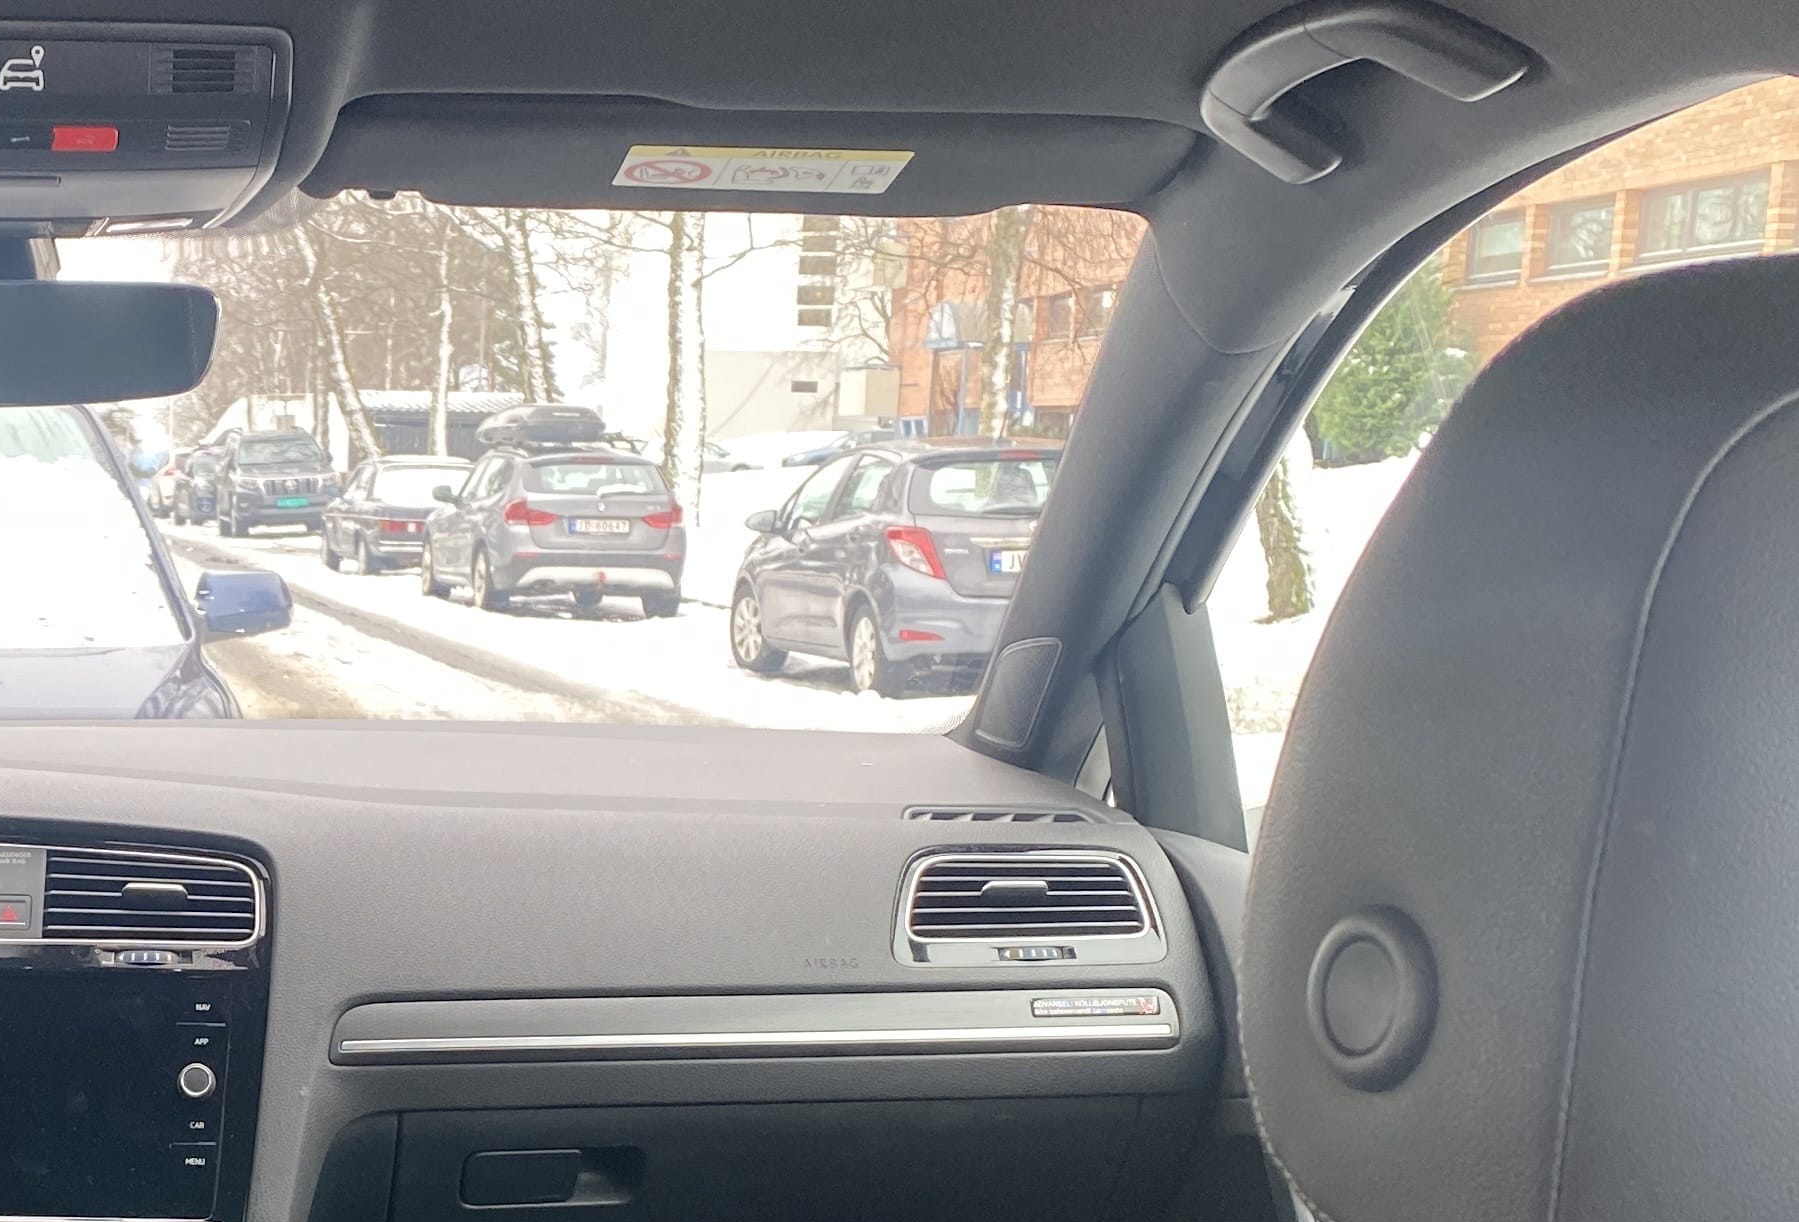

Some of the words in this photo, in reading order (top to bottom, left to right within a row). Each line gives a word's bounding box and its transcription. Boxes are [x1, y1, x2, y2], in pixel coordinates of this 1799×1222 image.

[752, 151, 842, 160] AIRBAG
[802, 957, 858, 969] AIRBAG
[195, 1003, 211, 1011] NAV
[194, 1038, 210, 1046] APP
[189, 1121, 205, 1129] CAR
[184, 1157, 206, 1166] MENU
